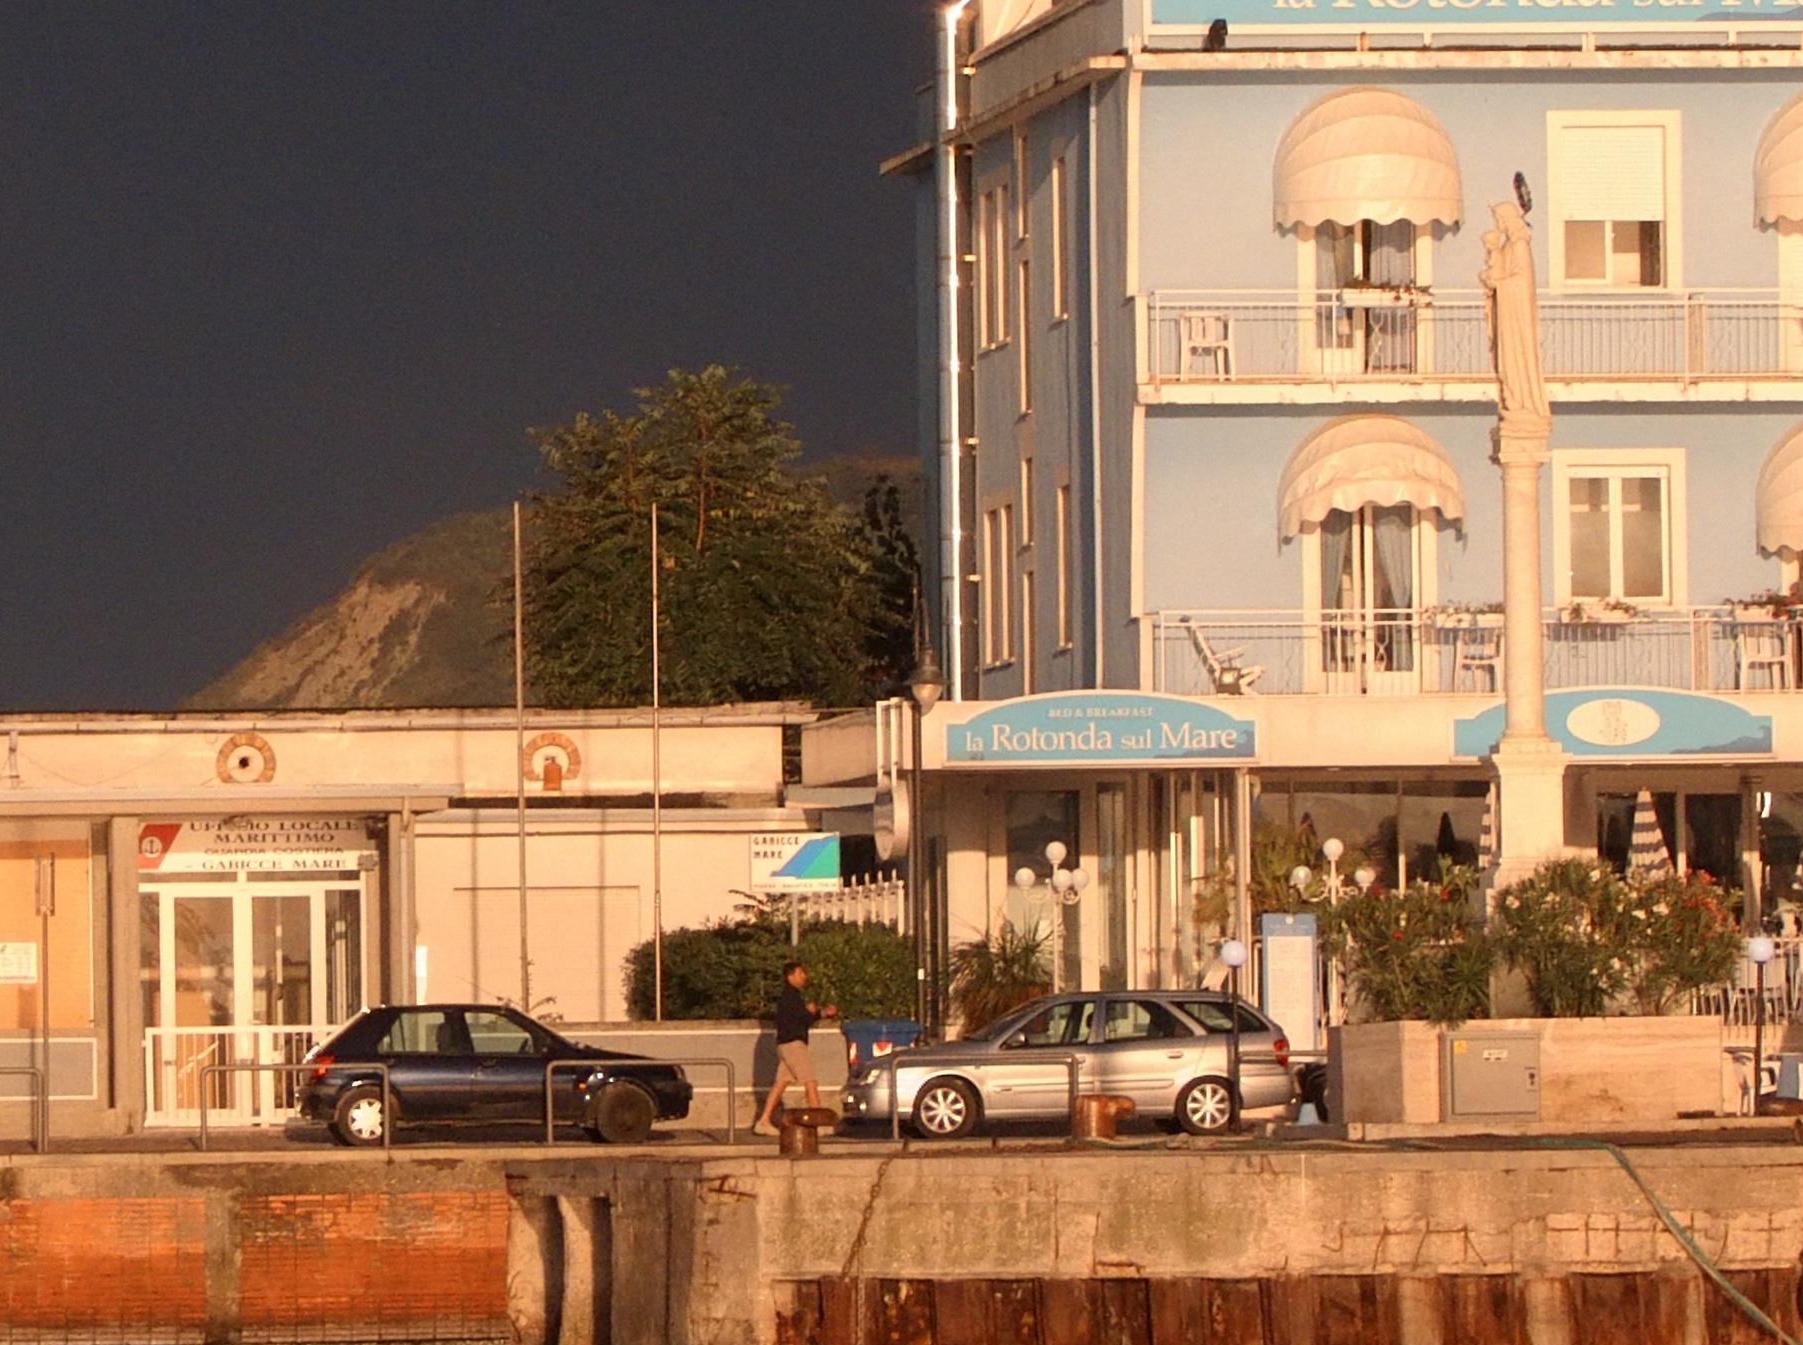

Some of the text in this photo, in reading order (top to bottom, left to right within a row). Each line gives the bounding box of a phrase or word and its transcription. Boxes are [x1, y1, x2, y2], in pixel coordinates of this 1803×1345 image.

[1085, 706, 1153, 718] BREAKFAST
[965, 721, 1238, 752] la Rotonda sul Mare
[190, 820, 359, 832] UFFIO LOCALE
[214, 833, 334, 843] MARITTIMO
[753, 837, 799, 845] GABICCE
[753, 851, 782, 859] MARE
[202, 859, 346, 870] GABICCE MARE
